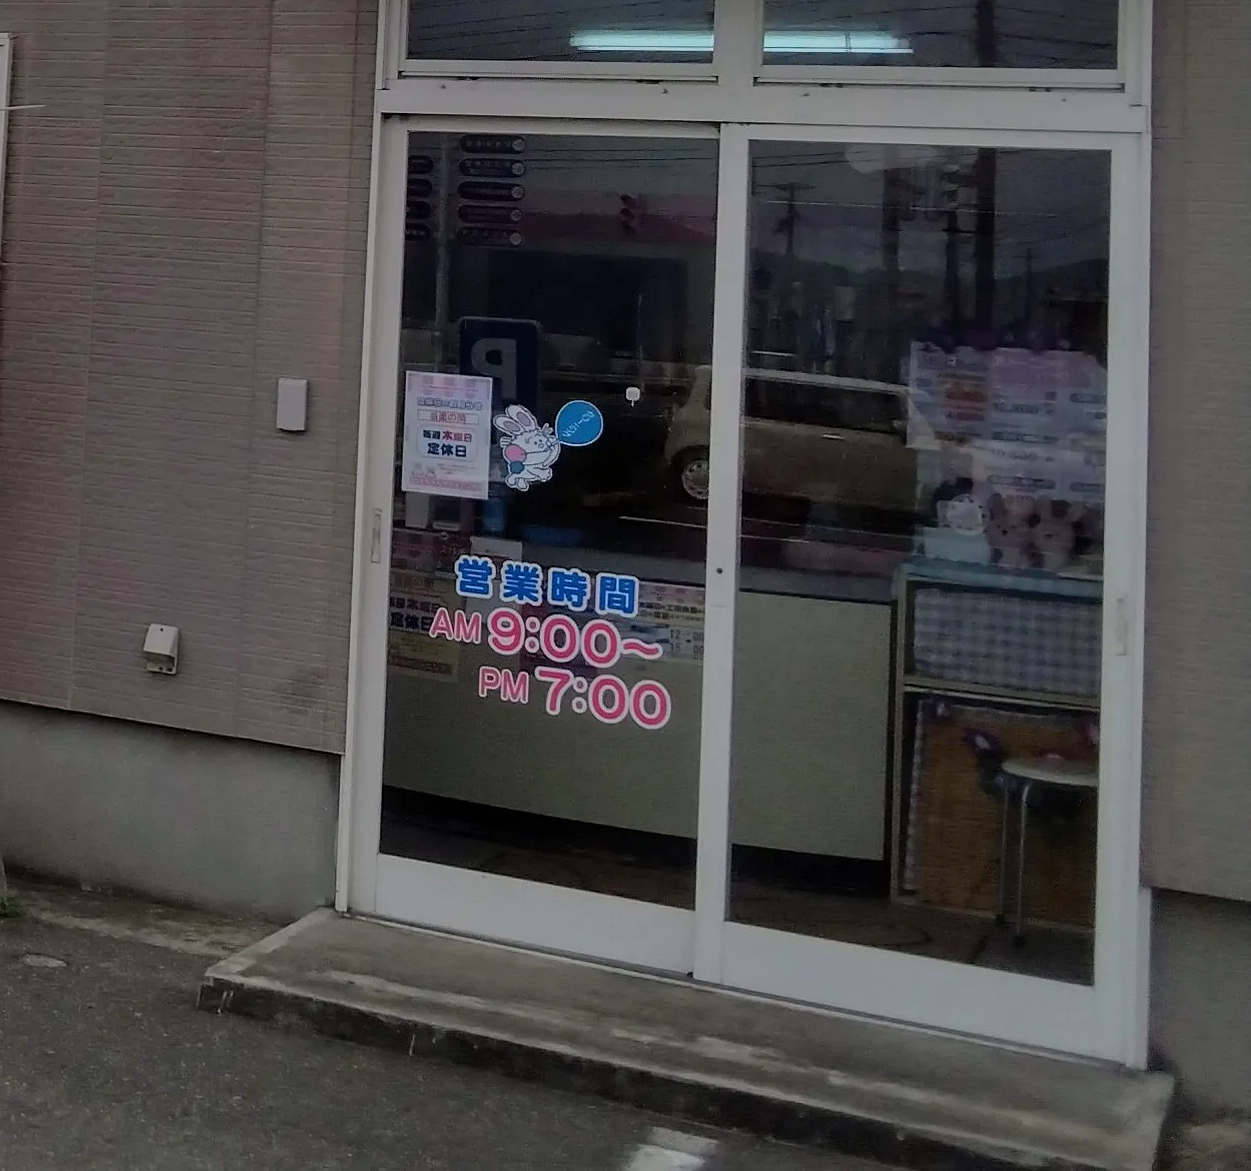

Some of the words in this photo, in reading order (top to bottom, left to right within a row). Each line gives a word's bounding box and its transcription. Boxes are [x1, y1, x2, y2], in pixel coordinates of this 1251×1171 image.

[426, 442, 468, 458] 定休日
[455, 556, 639, 615] 営業時間
[430, 608, 482, 645] AM
[479, 666, 530, 704] PM
[535, 666, 671, 729] 7:00
